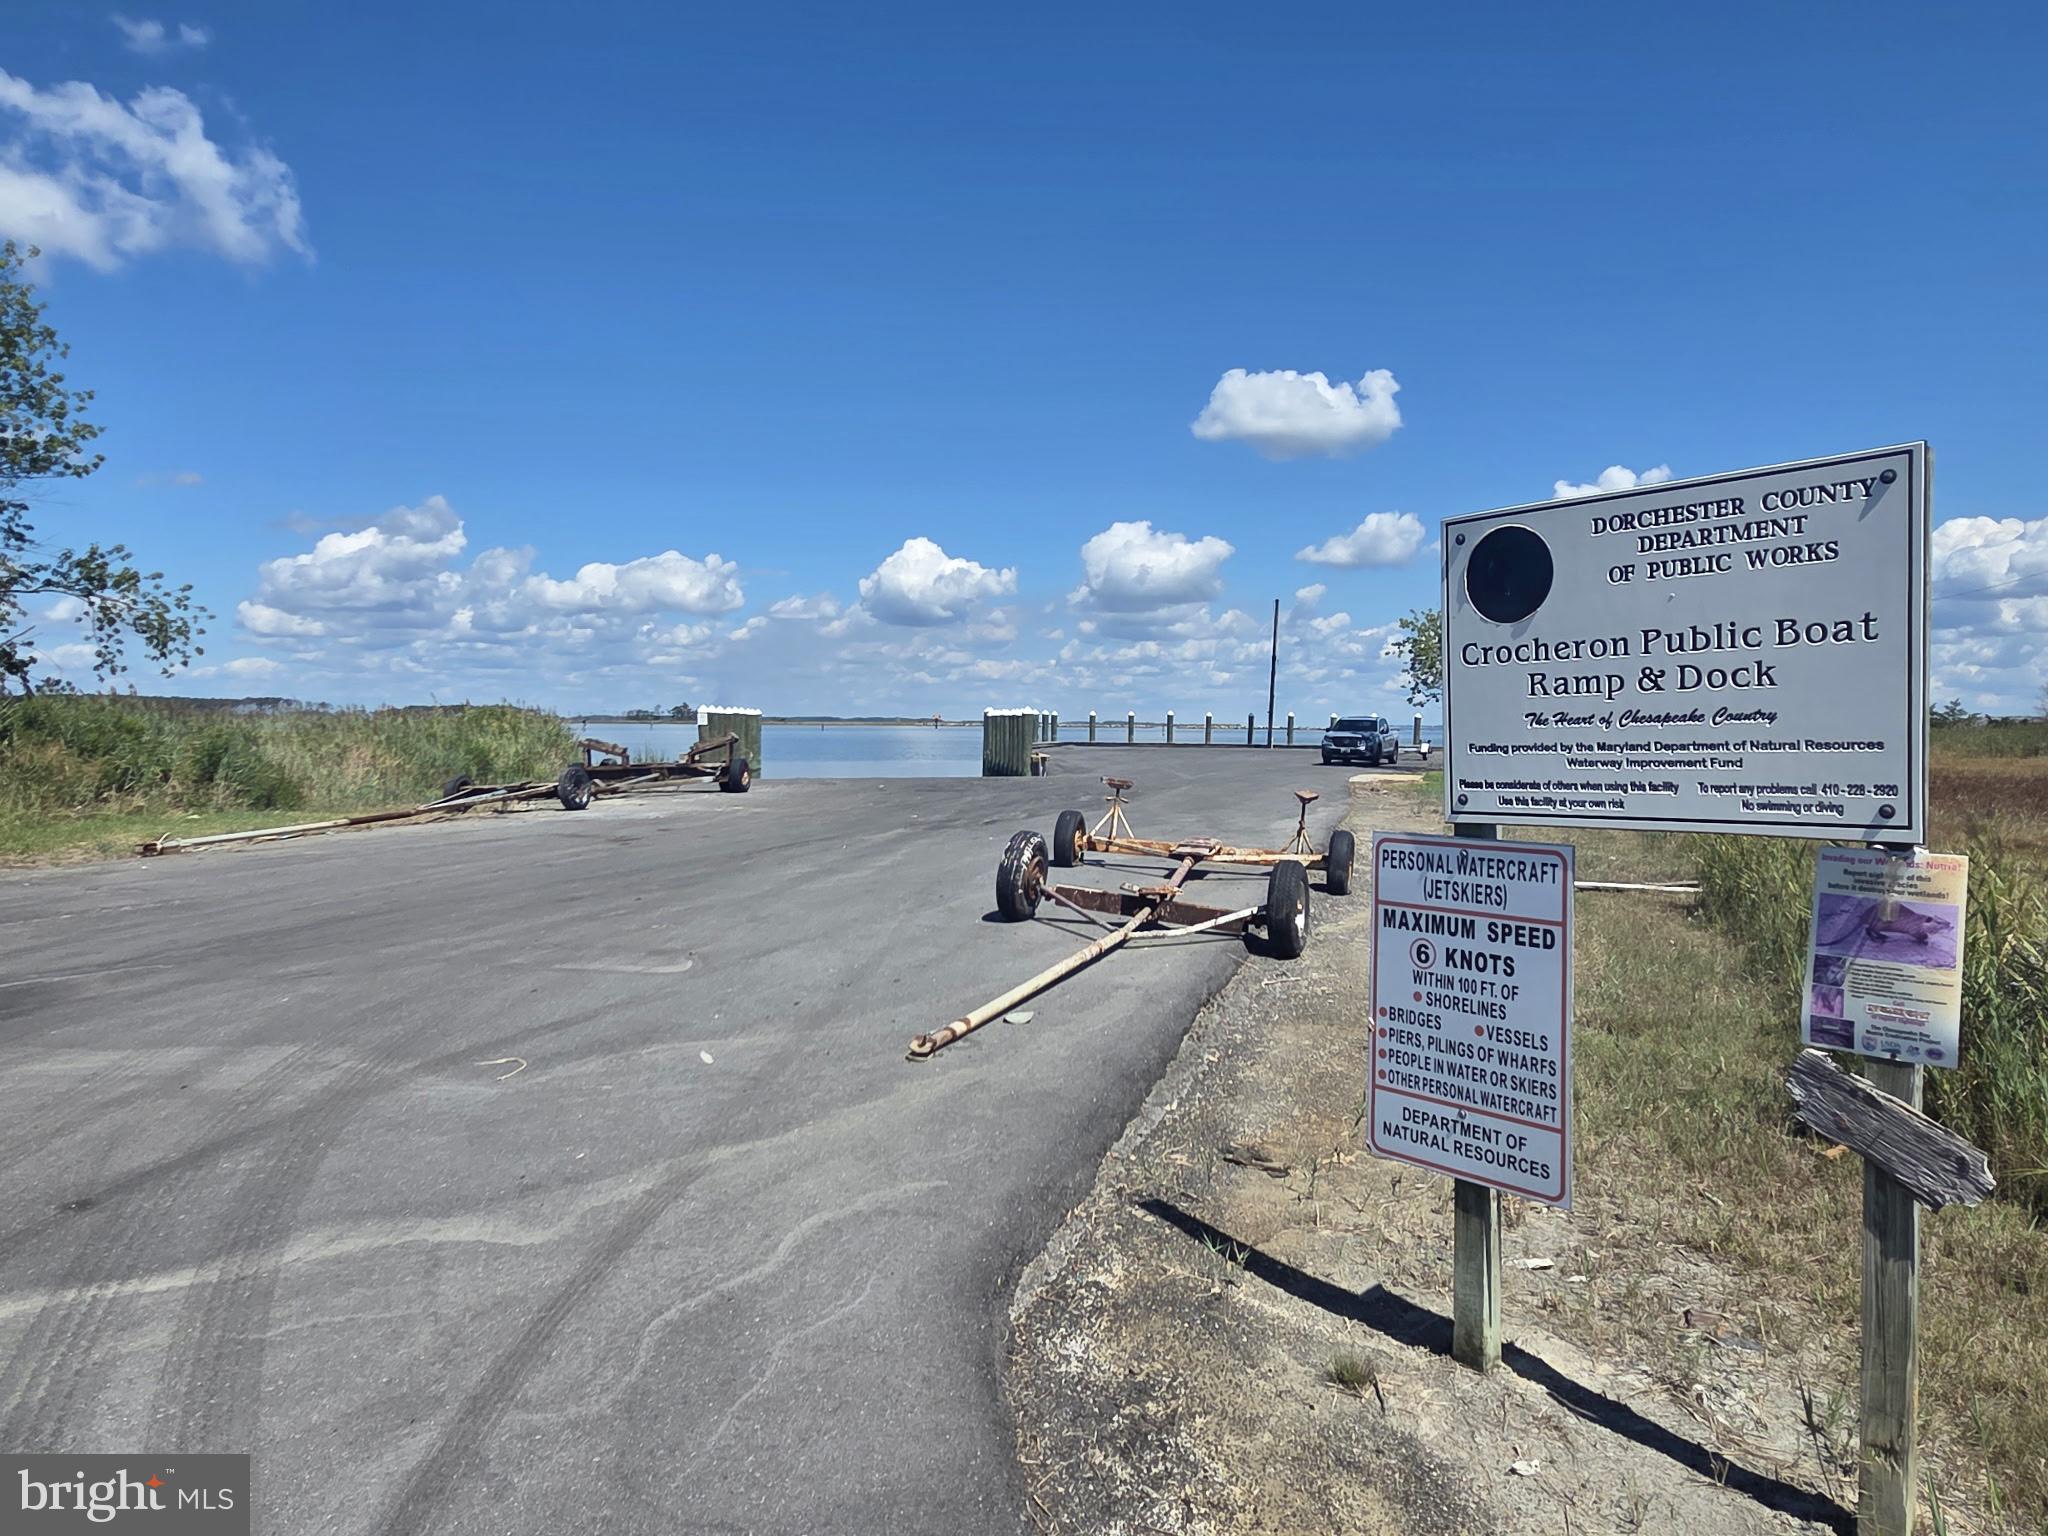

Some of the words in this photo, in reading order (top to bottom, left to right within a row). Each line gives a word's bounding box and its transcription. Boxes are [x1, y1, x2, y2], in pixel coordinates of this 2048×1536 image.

[1591, 497, 1746, 536] DORCHESTER
[1761, 477, 1877, 511] COUNTY
[1637, 515, 1808, 554] DEPARTMENT
[1607, 565, 1635, 584] OF
[1646, 553, 1732, 581] PUBLIC
[1745, 541, 1839, 570] WORKS
[1461, 637, 1630, 667] Crocheron
[1640, 621, 1762, 657] Public
[1773, 611, 1879, 648] Boat
[1527, 673, 1625, 703] Ramp
[1636, 666, 1666, 693] &
[1676, 660, 1778, 691] Dock
[1524, 712, 1549, 729] The
[1551, 711, 1595, 728] Heart
[1598, 711, 1614, 732] of
[1617, 708, 1705, 729] Chesapeake
[1710, 706, 1777, 728] Country
[1468, 743, 1509, 755] Funding
[1511, 742, 1557, 754] provided
[1559, 743, 1573, 754] by
[1575, 742, 1594, 753] the
[1596, 741, 1650, 754] Maryland
[1653, 741, 1731, 754] Department
[1733, 740, 1747, 751] of
[1750, 740, 1801, 752] Natural
[1804, 739, 1885, 751] Resources
[1565, 757, 1623, 769] Waterway
[1626, 757, 1708, 770] Improvement
[1710, 757, 1743, 769] Fund
[1459, 778, 1484, 790] Please
[1485, 779, 1494, 790] be
[1495, 779, 1541, 791] considerate
[1542, 780, 1552, 791] of
[1552, 780, 1578, 792] others
[1579, 781, 1601, 792] when
[1604, 781, 1628, 794] using
[1630, 781, 1646, 793] this
[1648, 781, 1679, 795] facility
[1498, 795, 1513, 807] Use
[1515, 796, 1529, 807] this
[1530, 796, 1557, 809] facility
[1558, 797, 1567, 808] at
[1568, 799, 1587, 811] your
[1588, 799, 1606, 810] own
[1608, 798, 1624, 810] risk
[1698, 782, 1709, 794] To
[1710, 782, 1737, 797] report
[1738, 784, 1754, 797] any
[1756, 782, 1798, 798] problems
[1800, 783, 1817, 795] call
[1741, 799, 1754, 811] No
[1756, 800, 1800, 815] swimming
[1802, 802, 1813, 813] or
[1815, 801, 1844, 817] diving
[1382, 849, 1453, 874] PERSONAL
[1457, 852, 1558, 884] WATERCRAFT
[1423, 877, 1508, 910] (JETSKIERS)
[1383, 908, 1476, 940] MAXIMUM
[1487, 921, 1555, 950] SPEED
[1416, 943, 1430, 964] 6
[1445, 947, 1515, 977] KNOTS
[1413, 970, 1454, 991] WITHIN
[1458, 977, 1477, 995] 100
[1481, 980, 1497, 998] FT.
[1501, 984, 1519, 1001] OF
[1389, 1006, 1442, 1030] BRIDGES
[1426, 991, 1506, 1020] SHORELINES
[1389, 1027, 1424, 1051] PIERS,
[1428, 1035, 1474, 1059] PILINGS
[1477, 1046, 1495, 1063] OF
[1498, 1050, 1557, 1077] WHARFS
[1486, 1024, 1548, 1051] VESSELS
[1389, 1048, 1431, 1072] PEOPLE
[1434, 1058, 1444, 1075] IN
[1447, 1060, 1487, 1084] WATER
[1490, 1071, 1508, 1089] OR
[1510, 1075, 1557, 1100] SKIERS
[1388, 1069, 1421, 1091] OTHER
[1422, 1076, 1478, 1105] PERSONAL
[1480, 1090, 1557, 1123] WATERCRAFT
[1402, 1106, 1501, 1146] DEPARTMENT
[1506, 1133, 1527, 1151] OF
[1383, 1121, 1449, 1152] NATURAL
[1454, 1140, 1550, 1180] RESOURCES
